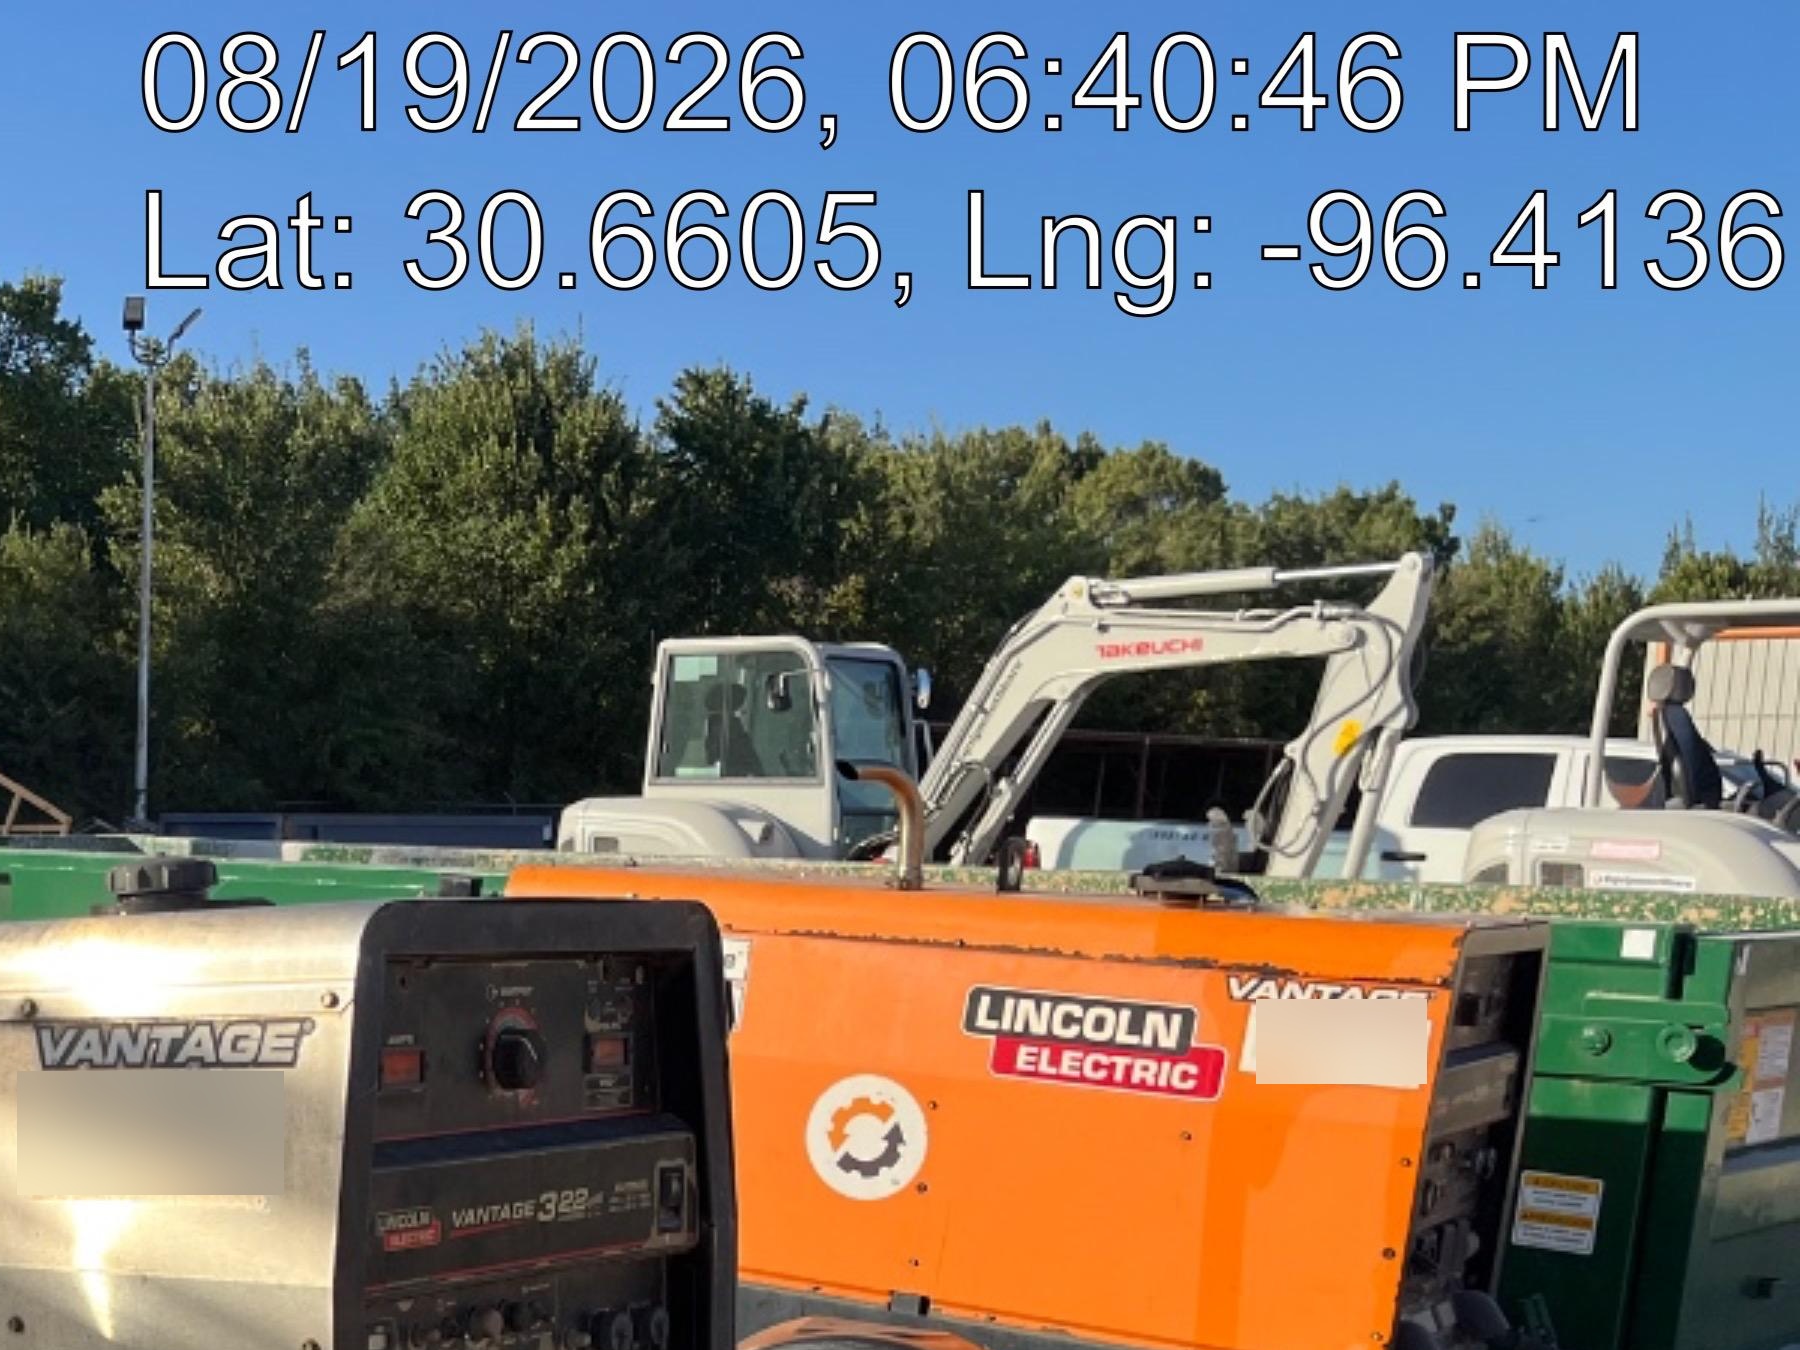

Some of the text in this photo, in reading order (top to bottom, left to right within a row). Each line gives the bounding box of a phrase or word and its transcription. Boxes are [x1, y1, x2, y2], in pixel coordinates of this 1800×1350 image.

[1229, 976, 1429, 1000] VANT
[37, 1019, 302, 1068] VANTAGE
[974, 995, 1182, 1050] LINCOLN
[1015, 1045, 1199, 1091] ELECTRIC
[452, 1199, 535, 1228] VANTAGE
